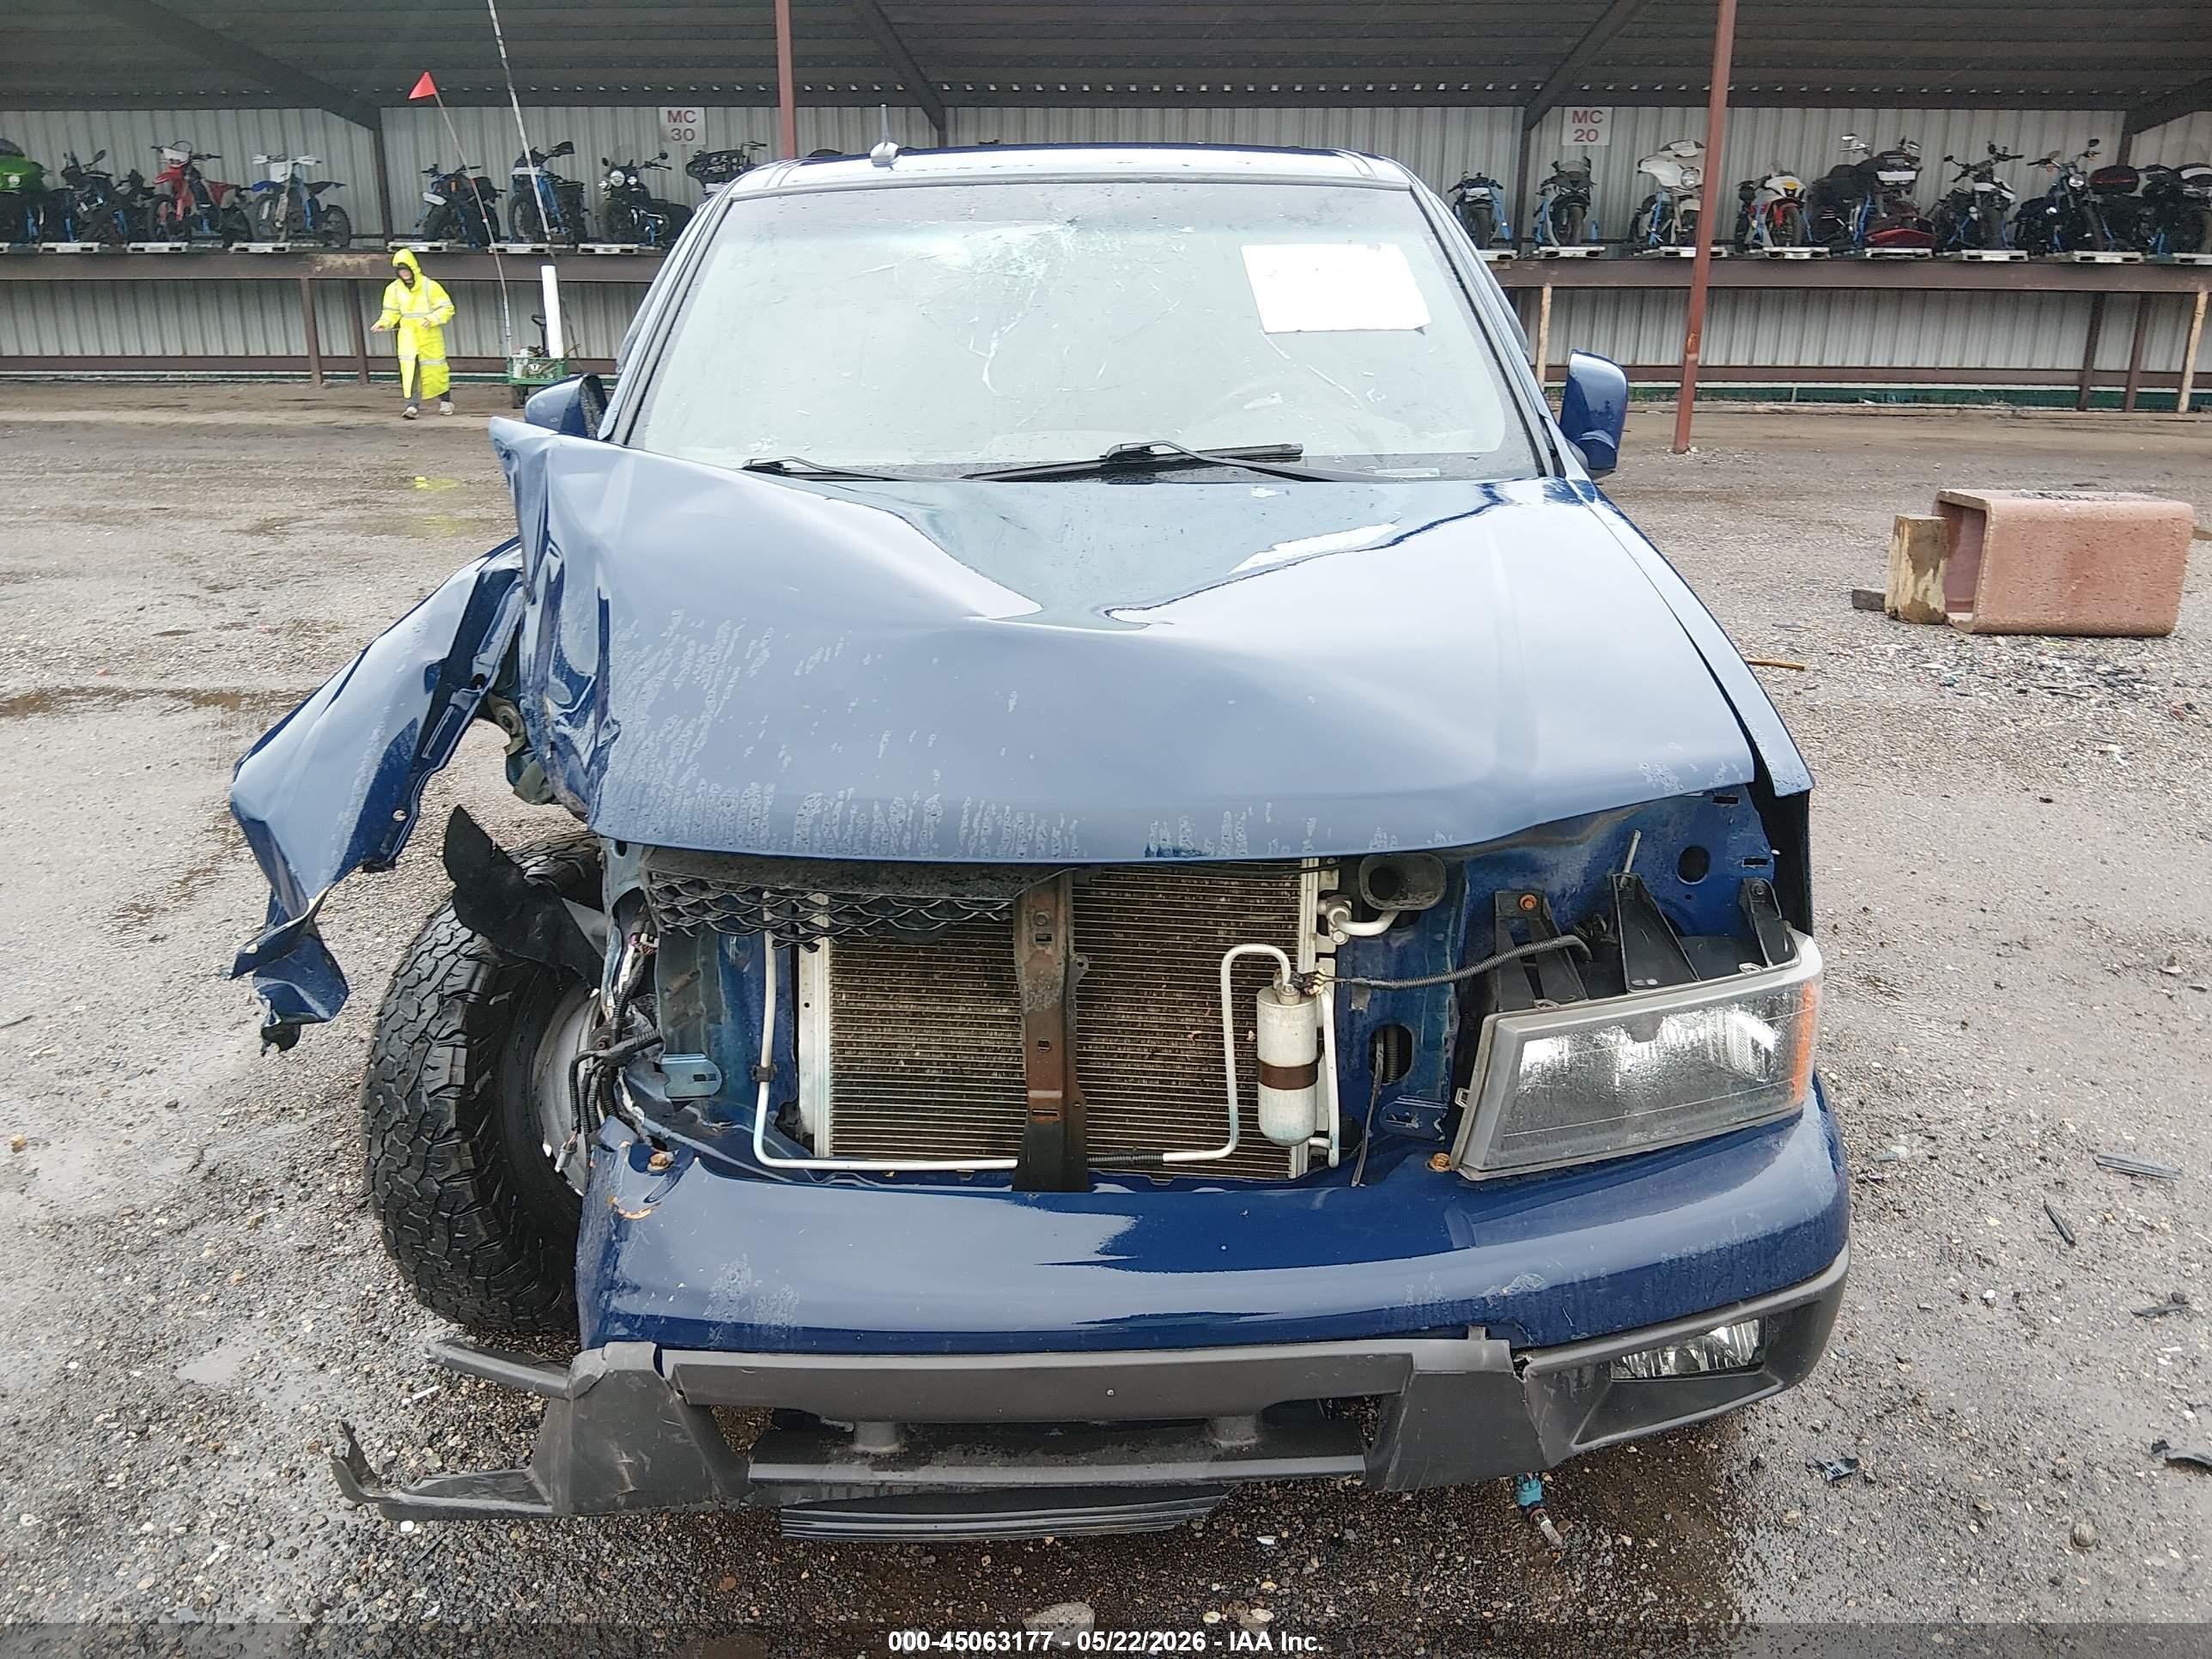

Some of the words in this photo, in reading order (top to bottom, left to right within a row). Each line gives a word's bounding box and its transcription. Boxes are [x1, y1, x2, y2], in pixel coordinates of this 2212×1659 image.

[667, 110, 696, 124] MC
[1572, 110, 1603, 124] MC
[671, 128, 696, 142] 30
[1573, 128, 1599, 143] 20
